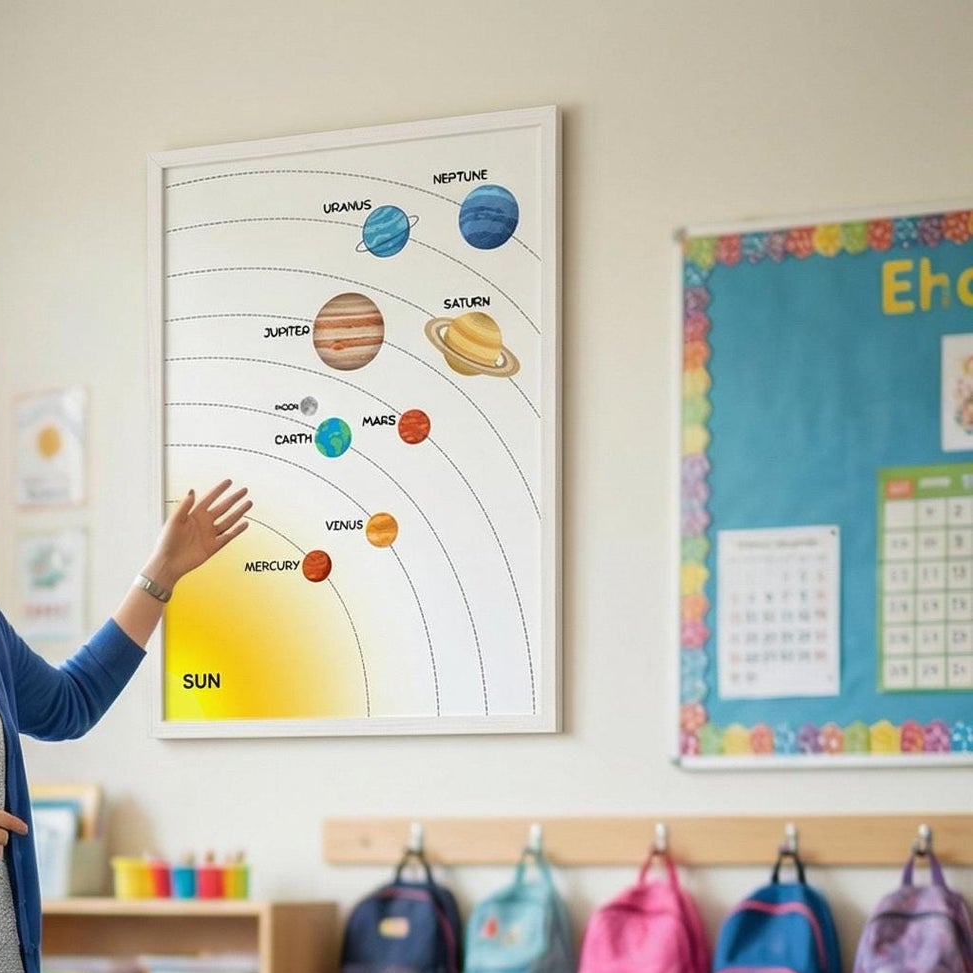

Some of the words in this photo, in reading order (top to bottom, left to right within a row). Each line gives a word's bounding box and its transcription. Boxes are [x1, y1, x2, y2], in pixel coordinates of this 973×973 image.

[433, 169, 488, 185] NEPTUNE
[323, 199, 372, 214] URANUS
[443, 296, 490, 309] SATURN
[325, 519, 364, 531] VENUS
[244, 560, 301, 573] MERCURY
[183, 673, 221, 690] SUN
